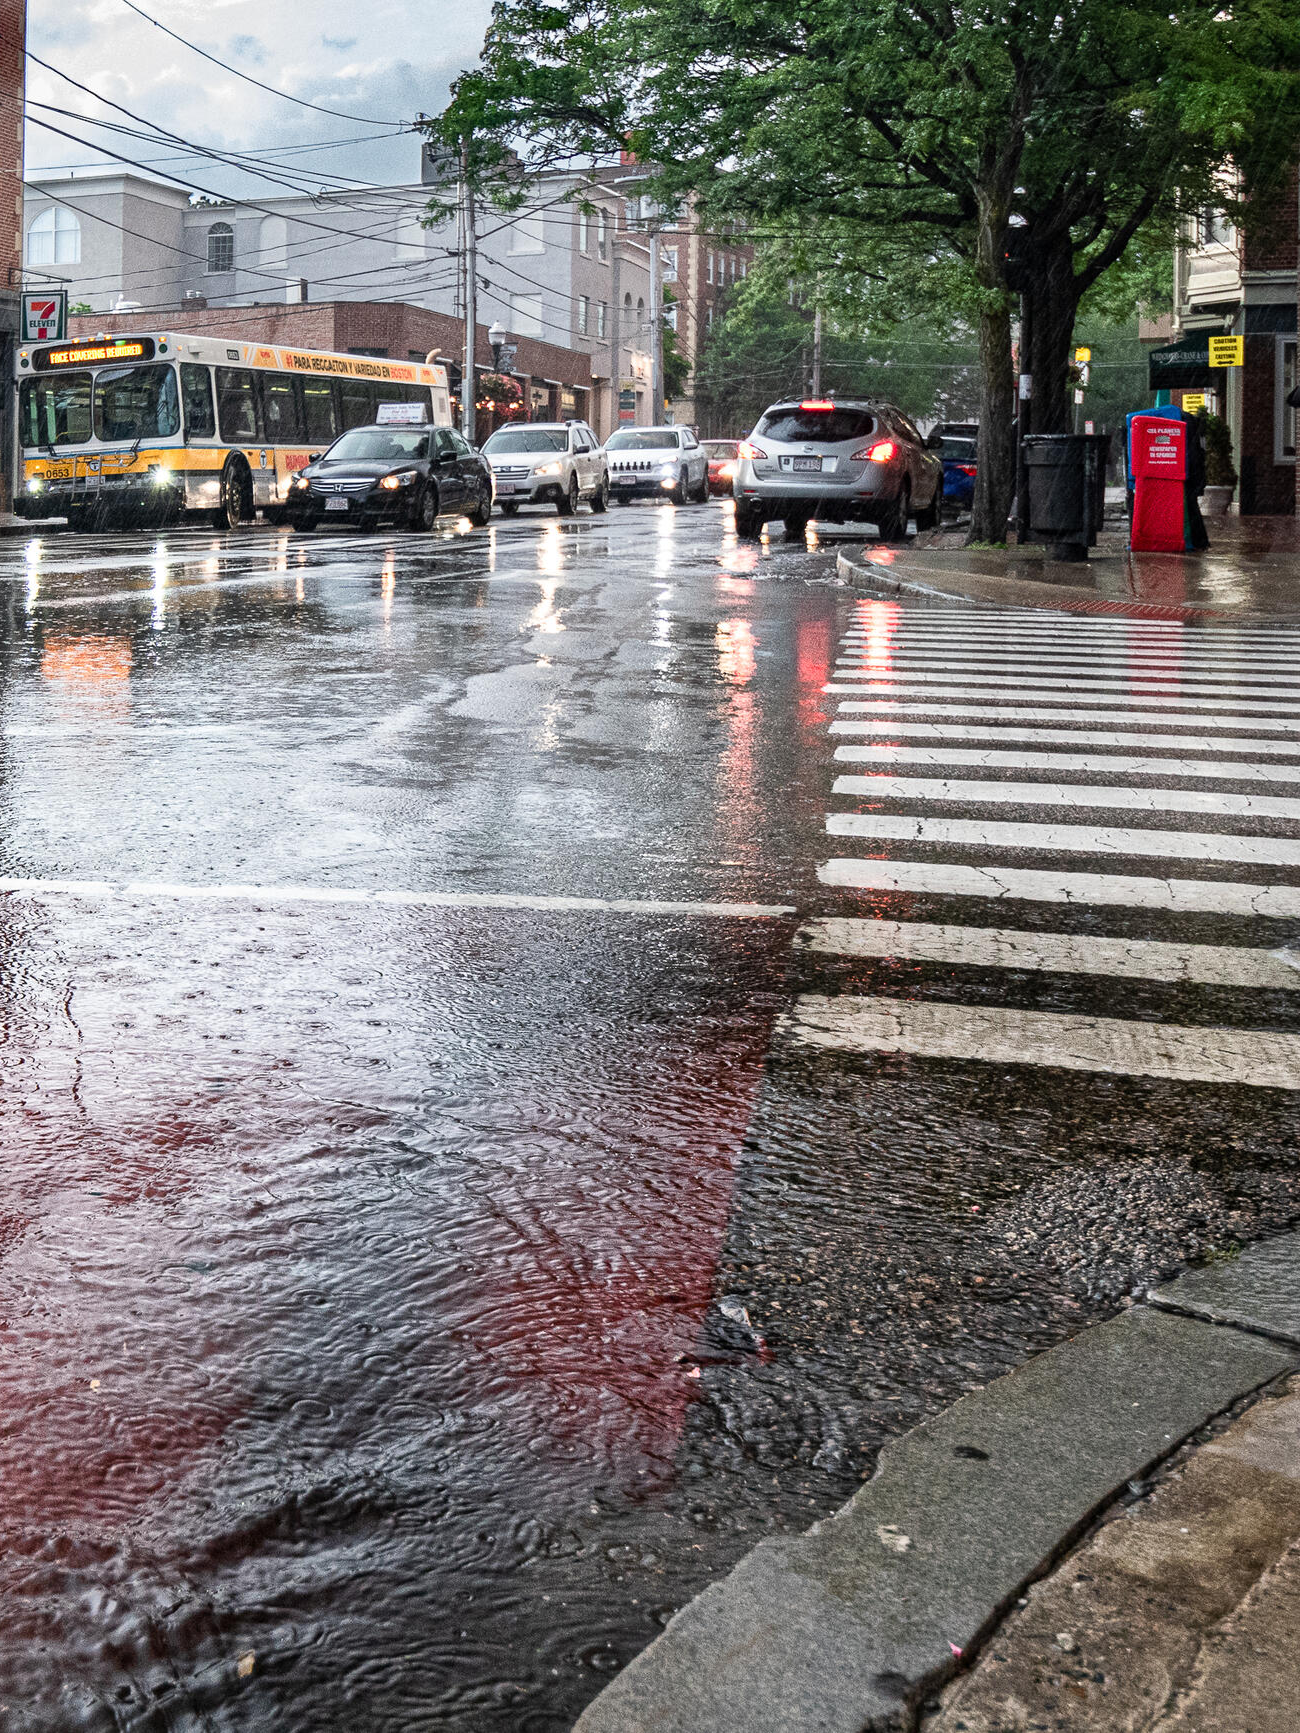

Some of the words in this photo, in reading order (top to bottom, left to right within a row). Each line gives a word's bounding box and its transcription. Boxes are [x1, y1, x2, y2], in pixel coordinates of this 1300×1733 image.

[50, 351, 69, 364] FACE
[69, 347, 105, 361] COVERING
[106, 344, 142, 358] REQUIRED
[293, 356, 311, 369] PARA
[348, 362, 353, 373] Y
[354, 362, 382, 377] VARIEDAD
[381, 366, 390, 378] EN
[390, 367, 413, 380] BOSTON
[46, 469, 70, 478] 0653
